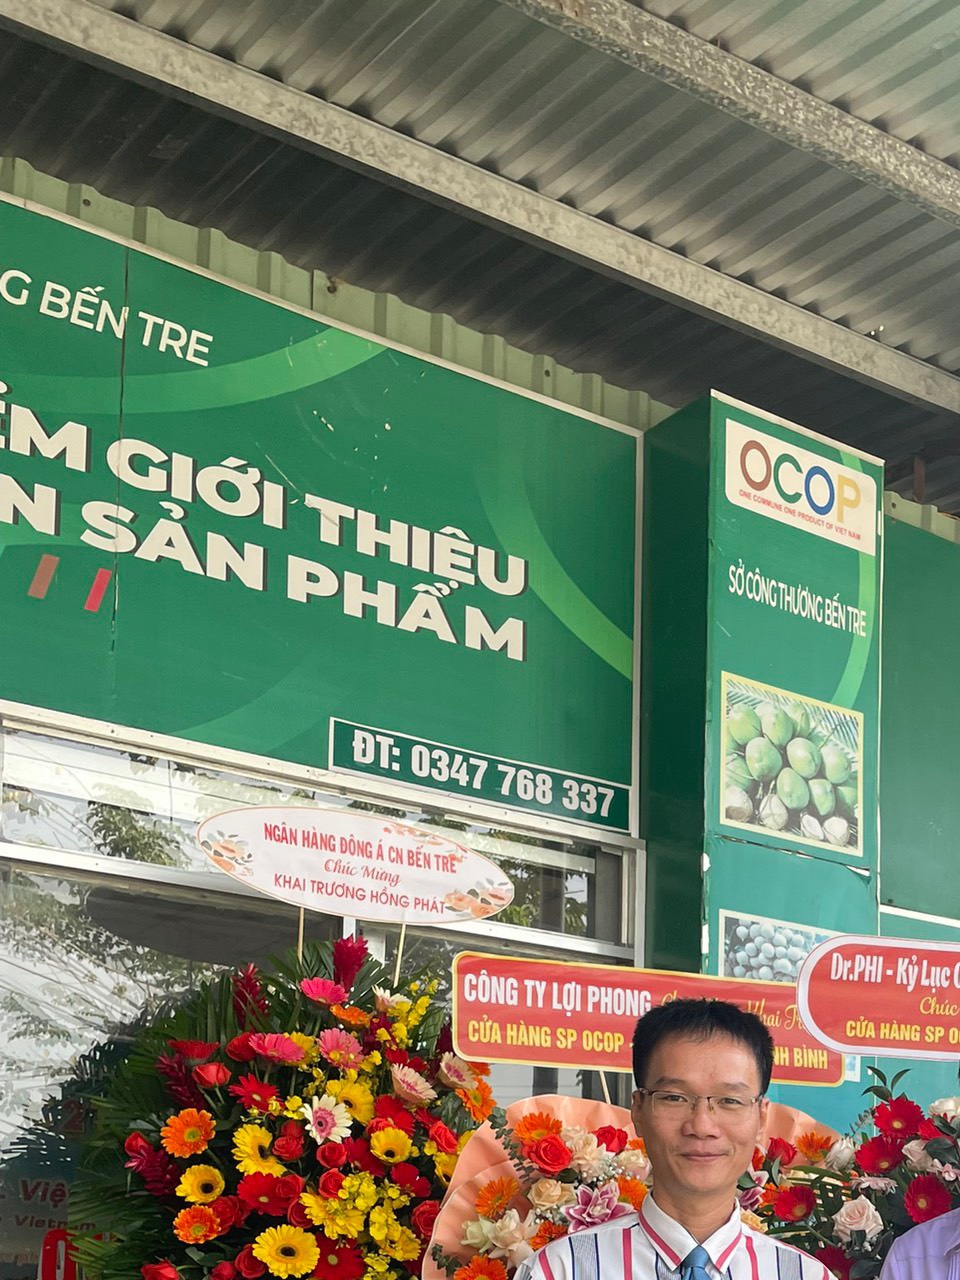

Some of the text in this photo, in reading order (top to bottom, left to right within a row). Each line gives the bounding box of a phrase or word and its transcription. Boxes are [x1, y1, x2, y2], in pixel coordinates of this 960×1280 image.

[40, 286, 126, 339] BẾN
[138, 310, 213, 367] TRE
[106, 438, 283, 529] GIỚI
[740, 440, 861, 523] OCOP
[739, 489, 861, 540] ONE COMMUNE ONE PRODUCT OF VIET NAM
[80, 501, 265, 591] SẢN
[287, 554, 524, 661] PHẨM
[729, 559, 866, 637] SỞ CÔNG THƯƠNG BẾN TRE
[352, 729, 615, 817] ĐT: 0347 768 337
[263, 821, 457, 874] NGÂN HÀNG ĐÔNG Á CN BẾN TRE
[324, 858, 402, 887] Chúc Mừng
[274, 873, 446, 914] KHAI TRƯƠNG HỒNG PHÁT
[464, 970, 518, 1006] CÔNG
[524, 979, 546, 1008] TY
[552, 980, 581, 1016] LỢI
[587, 985, 651, 1016] PHONG
[830, 952, 883, 983] Dr.PHI
[896, 955, 918, 992] Kỷ
[920, 960, 950, 993] Lục
[846, 1016, 875, 1038] CỬA
[880, 1020, 920, 1041] HÀNG
[925, 1027, 944, 1043] SP
[919, 996, 959, 1016] Chúc
[468, 1014, 502, 1044] CỬA
[506, 1020, 551, 1047] HÀNG
[556, 1028, 577, 1049] SP
[582, 1030, 624, 1053] OCOP
[793, 1044, 828, 1069] BÌNH
[21, 1180, 66, 1208] Việ
[15, 1216, 96, 1230] Vietnm
